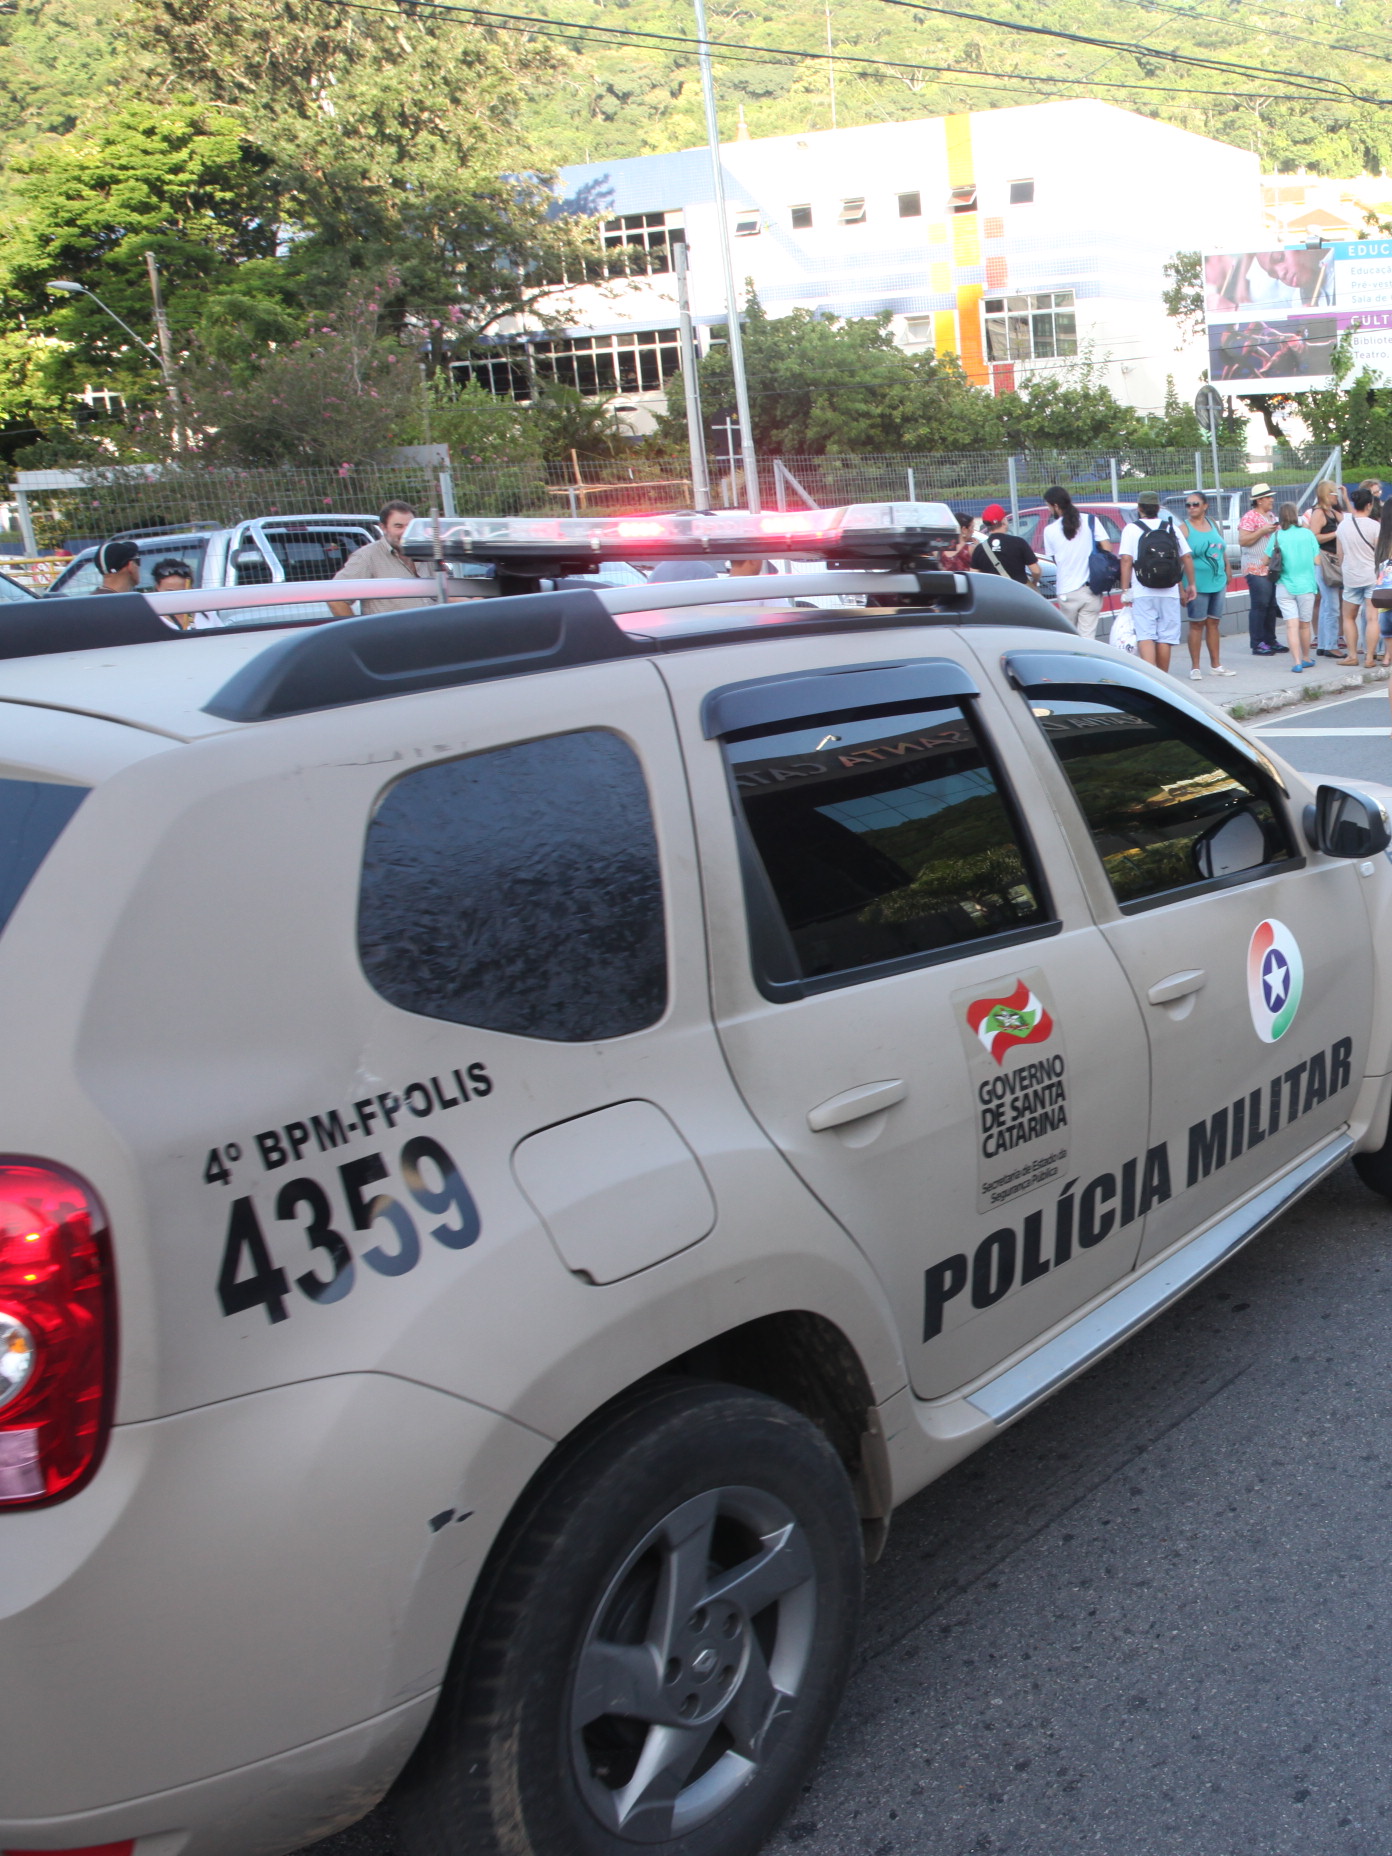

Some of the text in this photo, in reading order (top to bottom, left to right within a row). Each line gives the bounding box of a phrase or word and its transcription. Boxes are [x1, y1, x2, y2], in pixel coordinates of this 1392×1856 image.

[1351, 295, 1372, 304] Sala
[1375, 294, 1387, 303] de
[1354, 351, 1390, 362] Teatro,
[979, 1054, 1065, 1106] GOVERNO
[981, 1079, 1066, 1134] DE SANTA
[253, 1061, 494, 1171] BPM-FPOLIS
[982, 1104, 1068, 1159] CATARINA
[922, 1035, 1353, 1344] POLÍCIA MILITAR
[981, 1147, 1067, 1195] Secretaria de Estado da
[990, 1166, 1058, 1204] Segurança Pública
[216, 1135, 482, 1325] 4359
